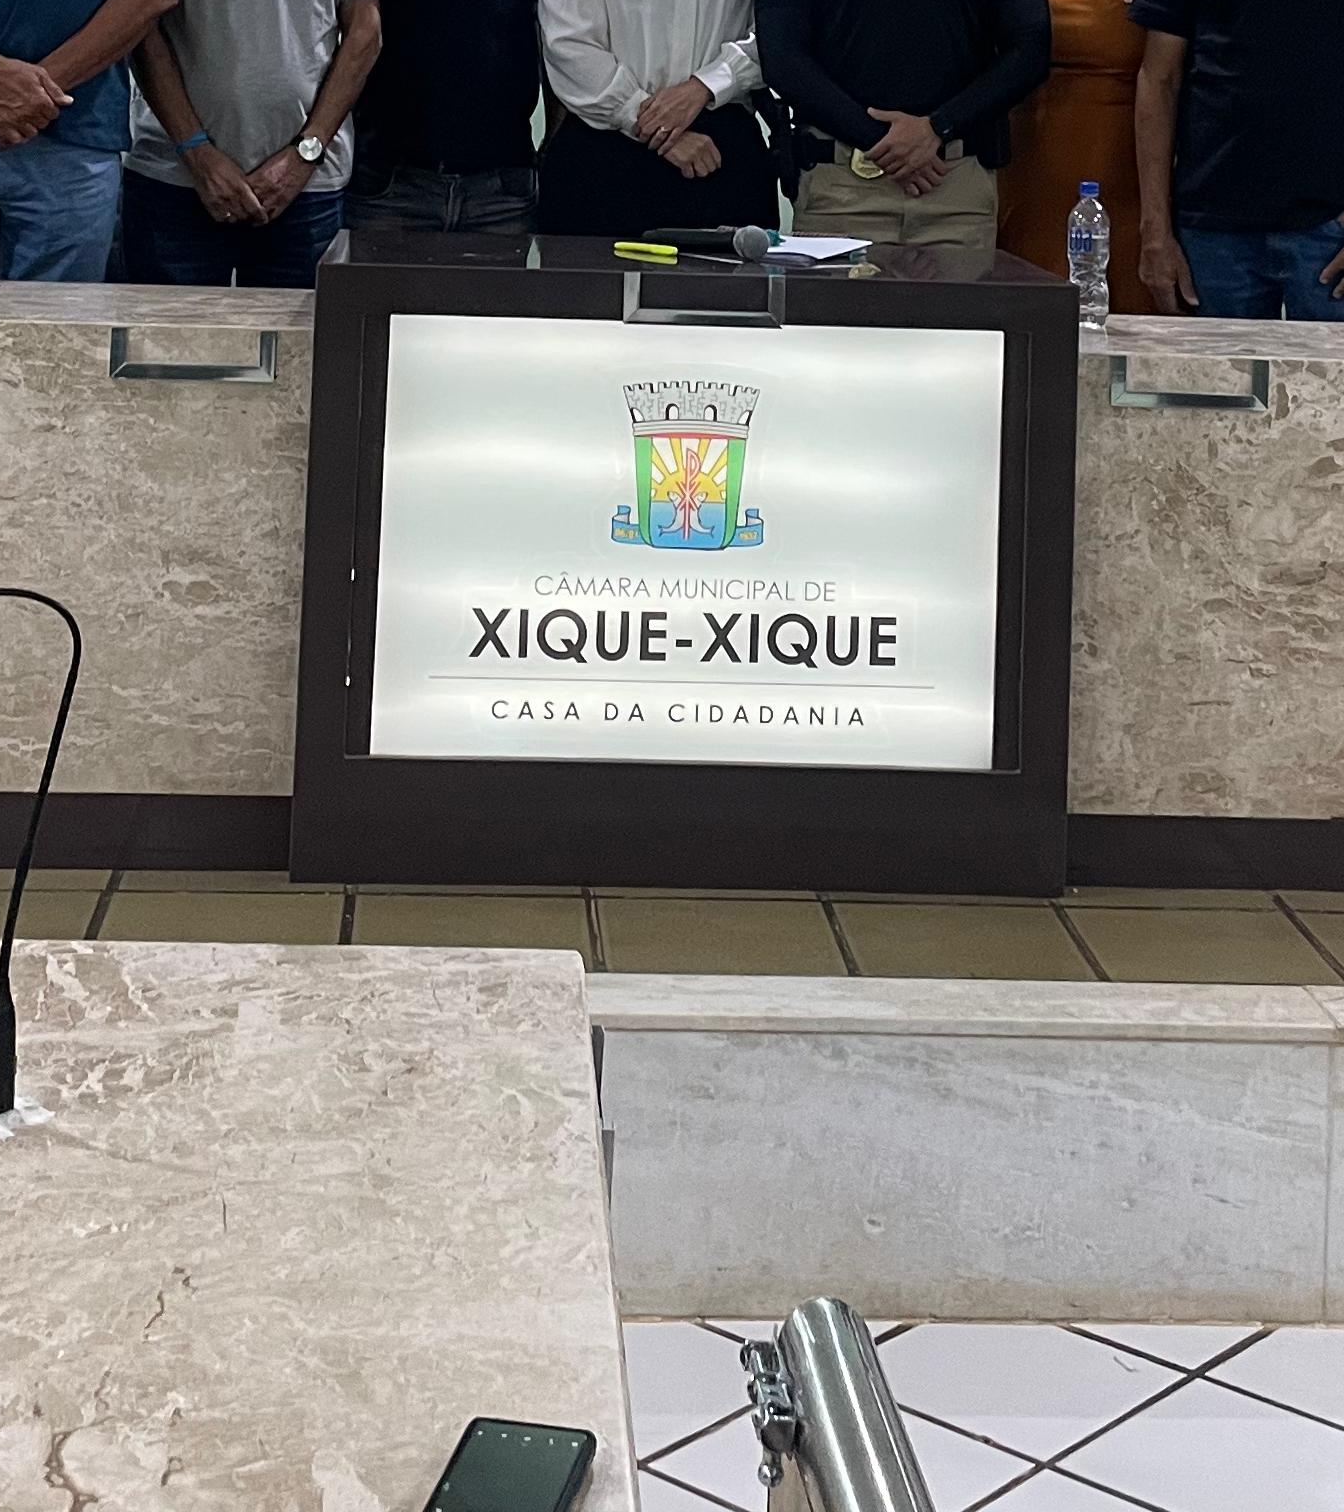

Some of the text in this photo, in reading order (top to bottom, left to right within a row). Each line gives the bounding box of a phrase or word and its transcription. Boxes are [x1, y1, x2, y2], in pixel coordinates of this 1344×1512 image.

[534, 571, 836, 602] CÂMARA MUNICIPAL DE
[468, 607, 897, 669] XIQUE-XIQUE
[491, 699, 865, 727] CASA DA CIDADANIA
